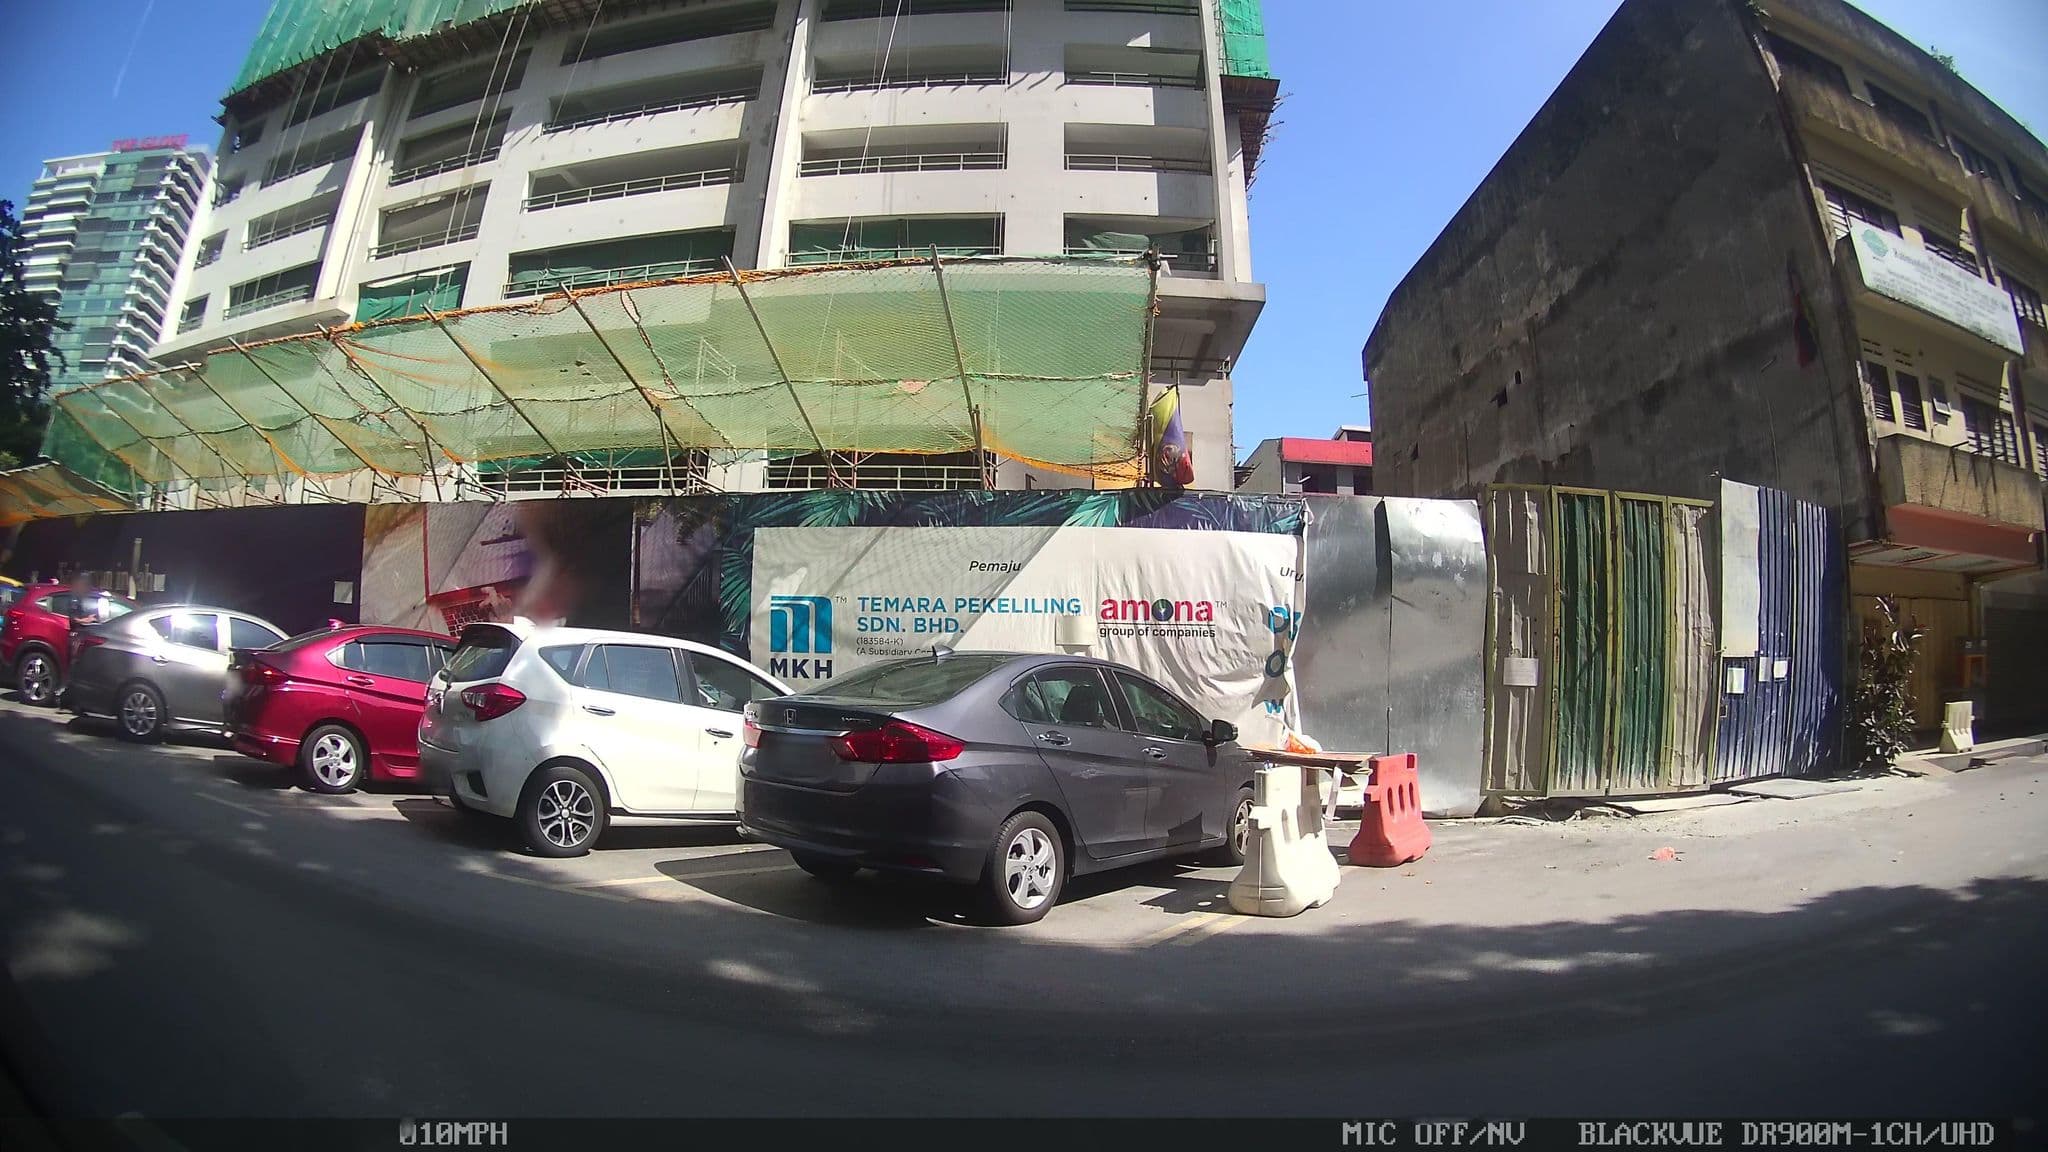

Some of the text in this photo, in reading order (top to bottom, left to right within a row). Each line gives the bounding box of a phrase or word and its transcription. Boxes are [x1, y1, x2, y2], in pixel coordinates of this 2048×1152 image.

[968, 560, 1022, 573] Pemaju
[834, 596, 848, 604] TM
[857, 596, 1082, 614] TEMARA PEKELILING
[1100, 598, 1213, 622] amona
[857, 617, 965, 633] SDN. BHD.
[1100, 626, 1216, 640] group of companies
[856, 637, 904, 647] (183584-K)
[856, 648, 867, 657] (A
[867, 648, 913, 658] Subsidiary
[770, 658, 833, 679] MKH
